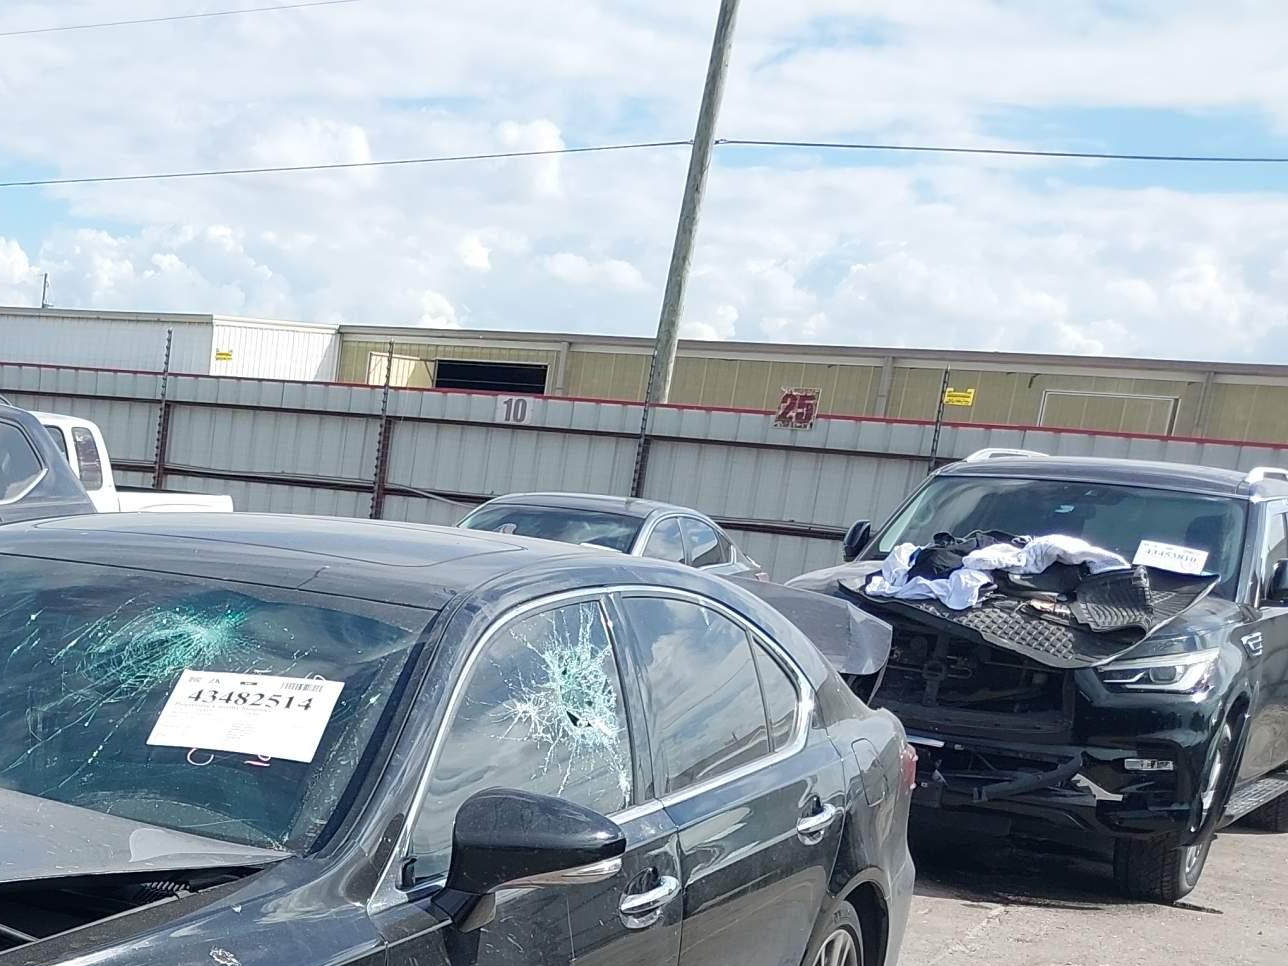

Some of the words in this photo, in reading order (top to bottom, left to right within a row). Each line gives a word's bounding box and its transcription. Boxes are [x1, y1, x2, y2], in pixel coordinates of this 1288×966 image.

[503, 398, 528, 423] 10
[776, 393, 816, 424] 25
[188, 688, 313, 711] 43482514
